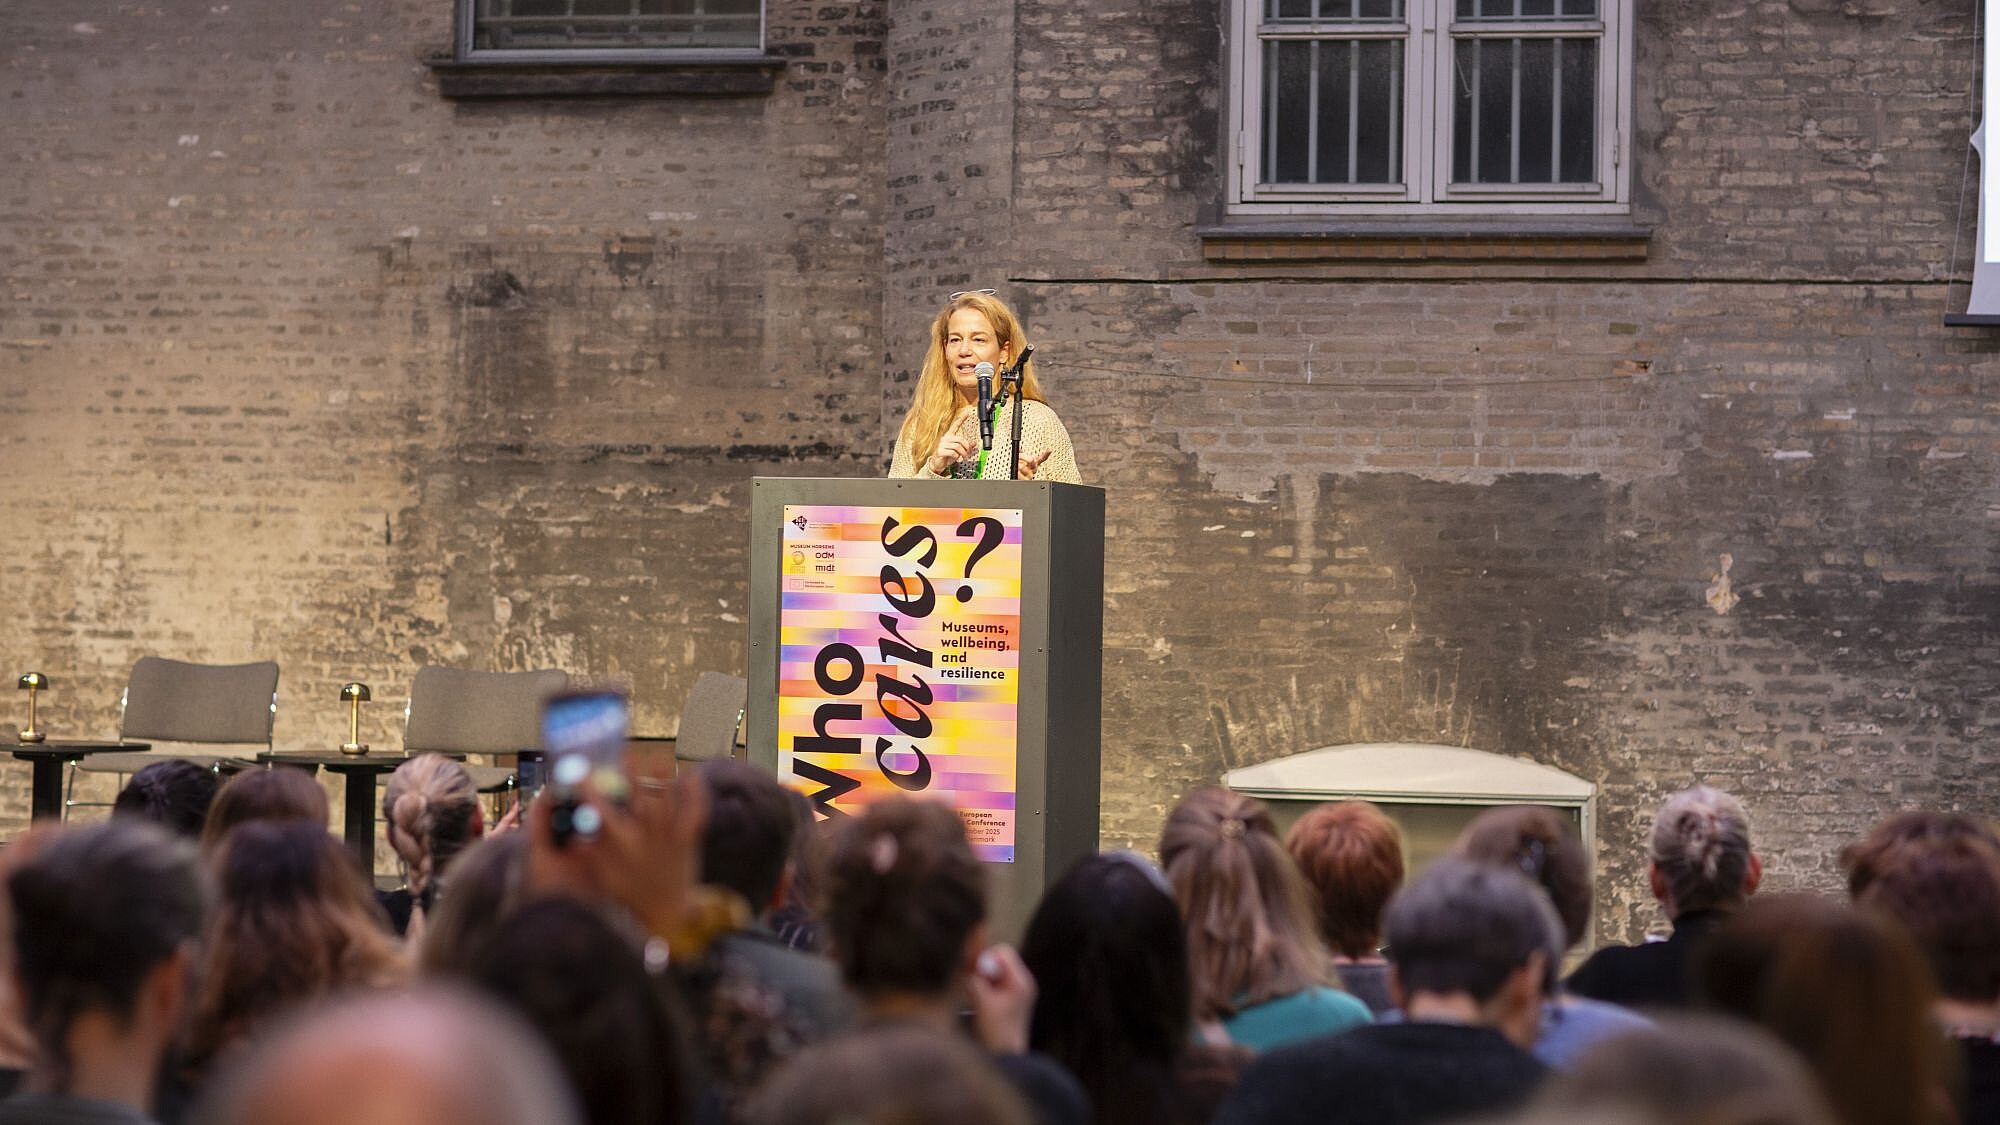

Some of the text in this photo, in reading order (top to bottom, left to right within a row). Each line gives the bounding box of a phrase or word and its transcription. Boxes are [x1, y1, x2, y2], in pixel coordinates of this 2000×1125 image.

[955, 516, 1005, 604] ?
[942, 621, 1009, 635] Museums,
[941, 636, 1010, 651] wellbeing,
[875, 516, 938, 792] cares
[941, 651, 967, 663] and
[940, 667, 1005, 679] resilience
